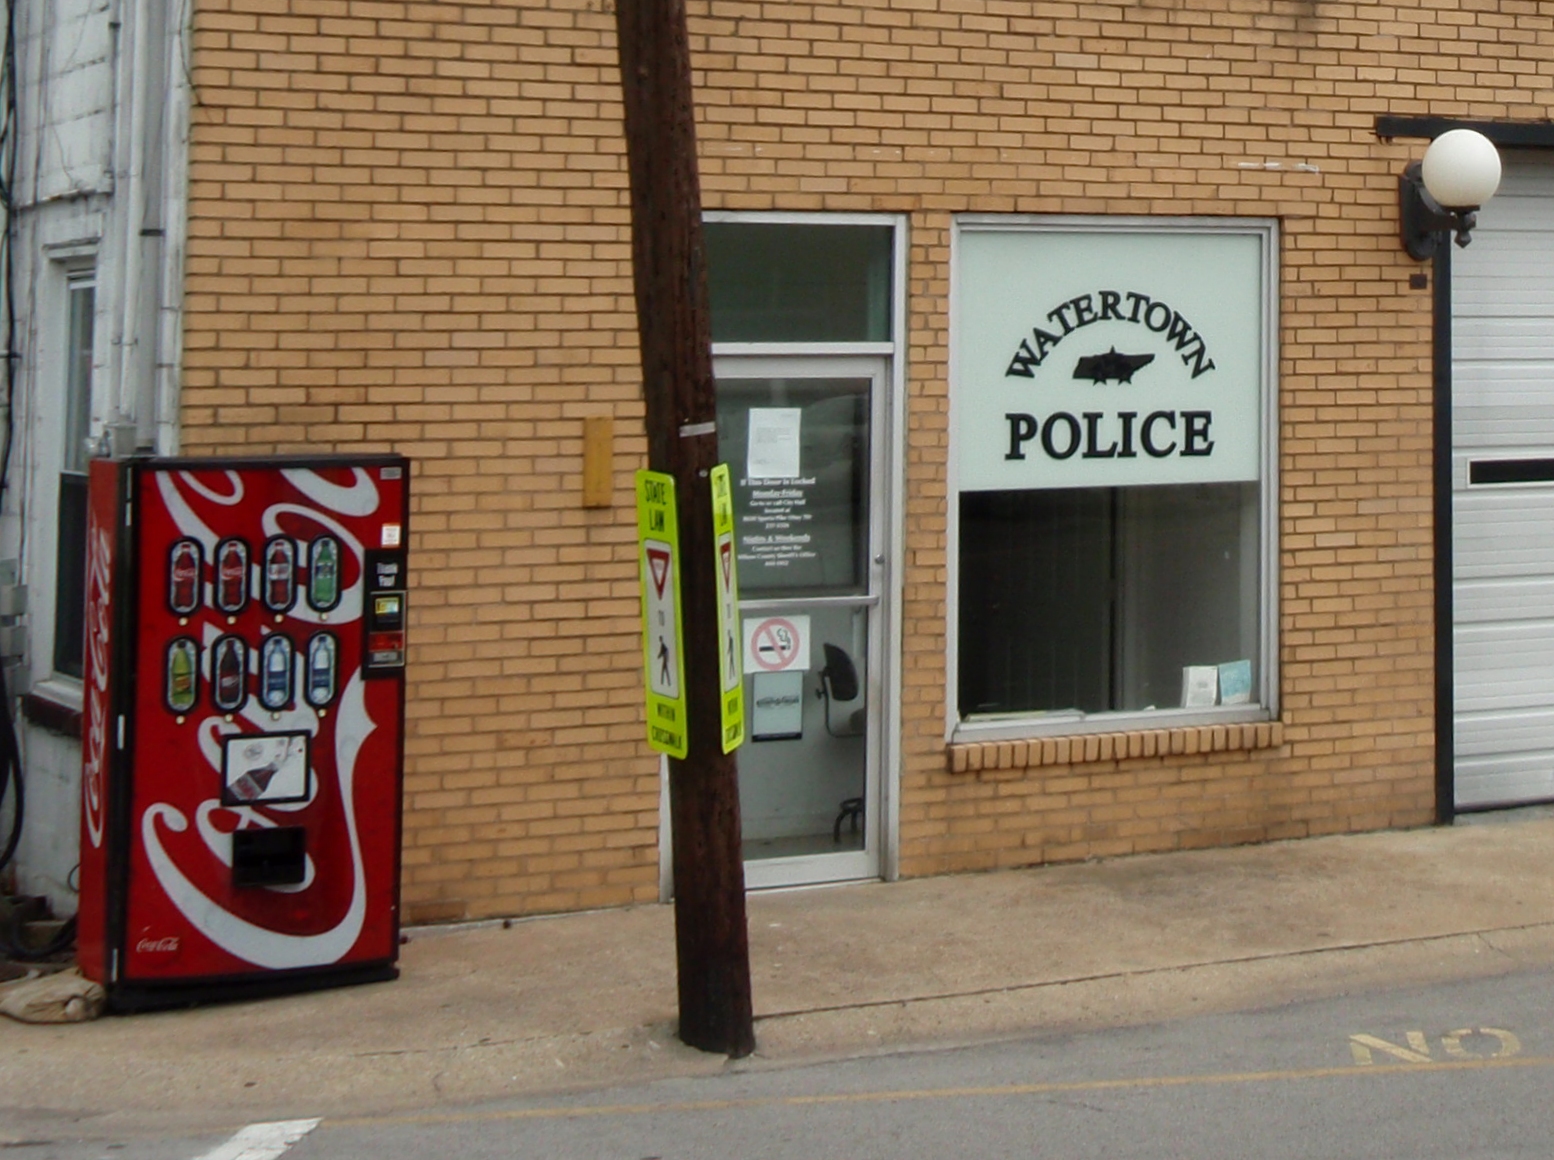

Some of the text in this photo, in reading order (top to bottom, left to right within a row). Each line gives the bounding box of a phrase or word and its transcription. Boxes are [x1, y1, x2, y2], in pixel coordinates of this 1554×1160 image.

[1004, 290, 1216, 380] WATERTOWN
[1004, 410, 1215, 460] POLICE
[645, 479, 667, 505] STATE
[649, 509, 665, 532] LAW
[83, 510, 111, 849] Coca-Cola
[1349, 1027, 1521, 1066] NO
